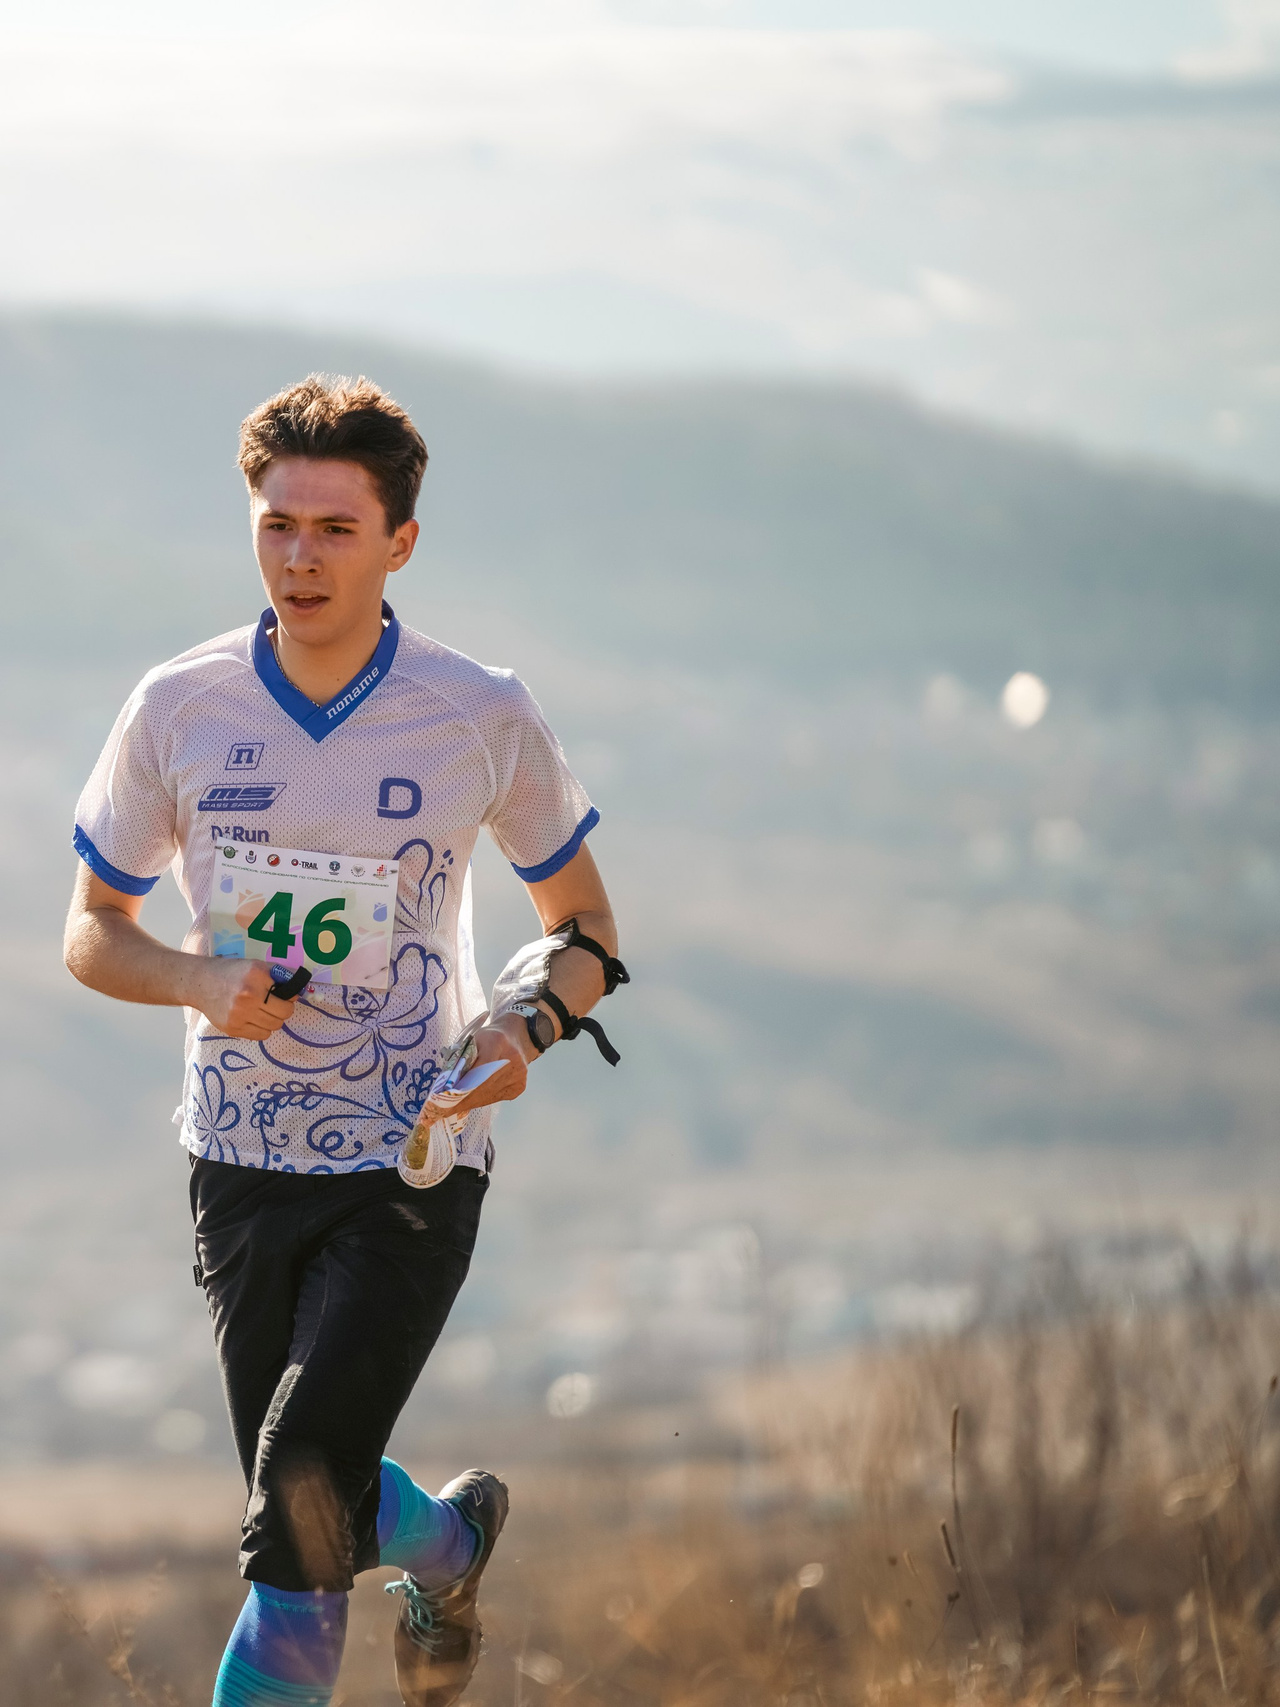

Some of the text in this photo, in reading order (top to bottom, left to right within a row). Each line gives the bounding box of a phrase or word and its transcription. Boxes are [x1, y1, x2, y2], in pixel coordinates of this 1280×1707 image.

[326, 666, 380, 720] noname
[376, 777, 423, 819] D
[247, 891, 353, 966] 46
